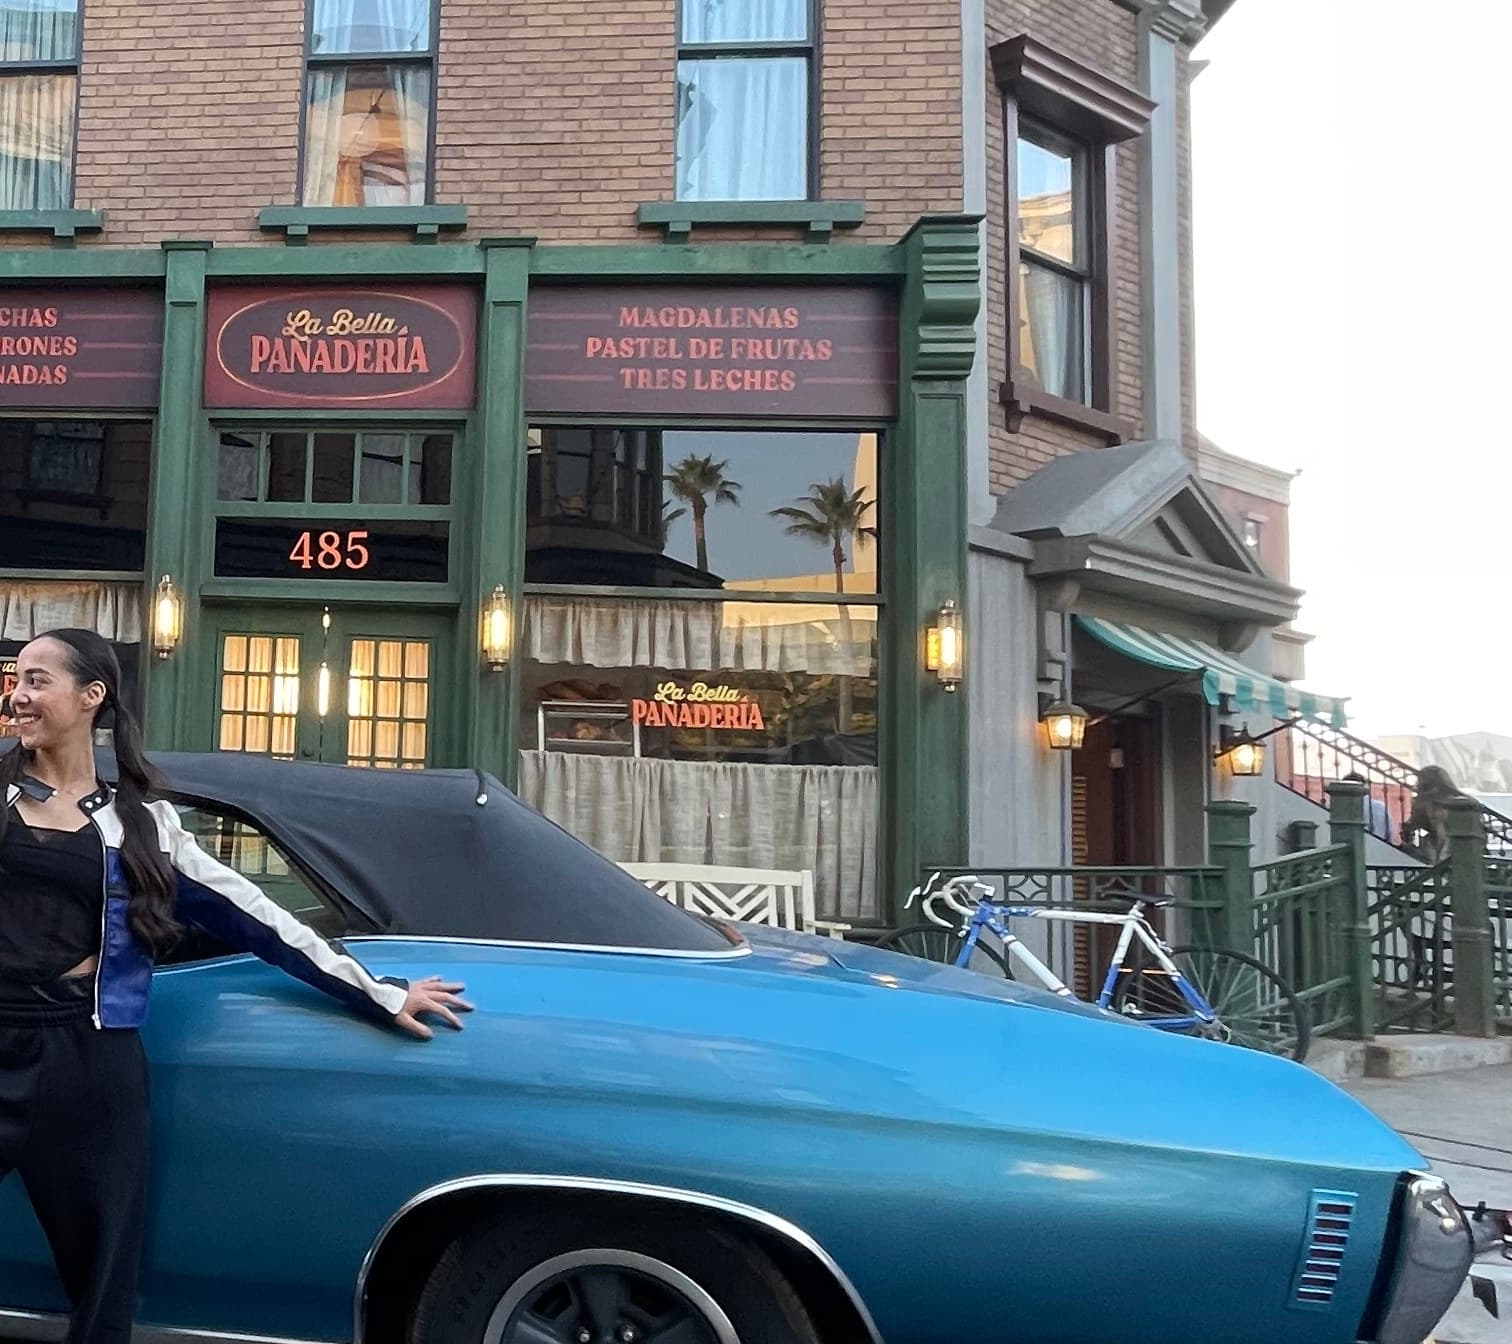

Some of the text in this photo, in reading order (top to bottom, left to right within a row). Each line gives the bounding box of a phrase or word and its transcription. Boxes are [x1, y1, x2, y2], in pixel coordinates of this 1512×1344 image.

[281, 308, 399, 342] La Bella
[618, 306, 800, 329] MAGDALENAS
[250, 325, 430, 374] PANADERÍA
[586, 336, 833, 361] PASTEL DE FRUTAS
[619, 367, 797, 392] TRES LECHES
[289, 530, 369, 570] 485
[653, 681, 741, 704] La Bella
[632, 694, 765, 730] PANADERÍA
